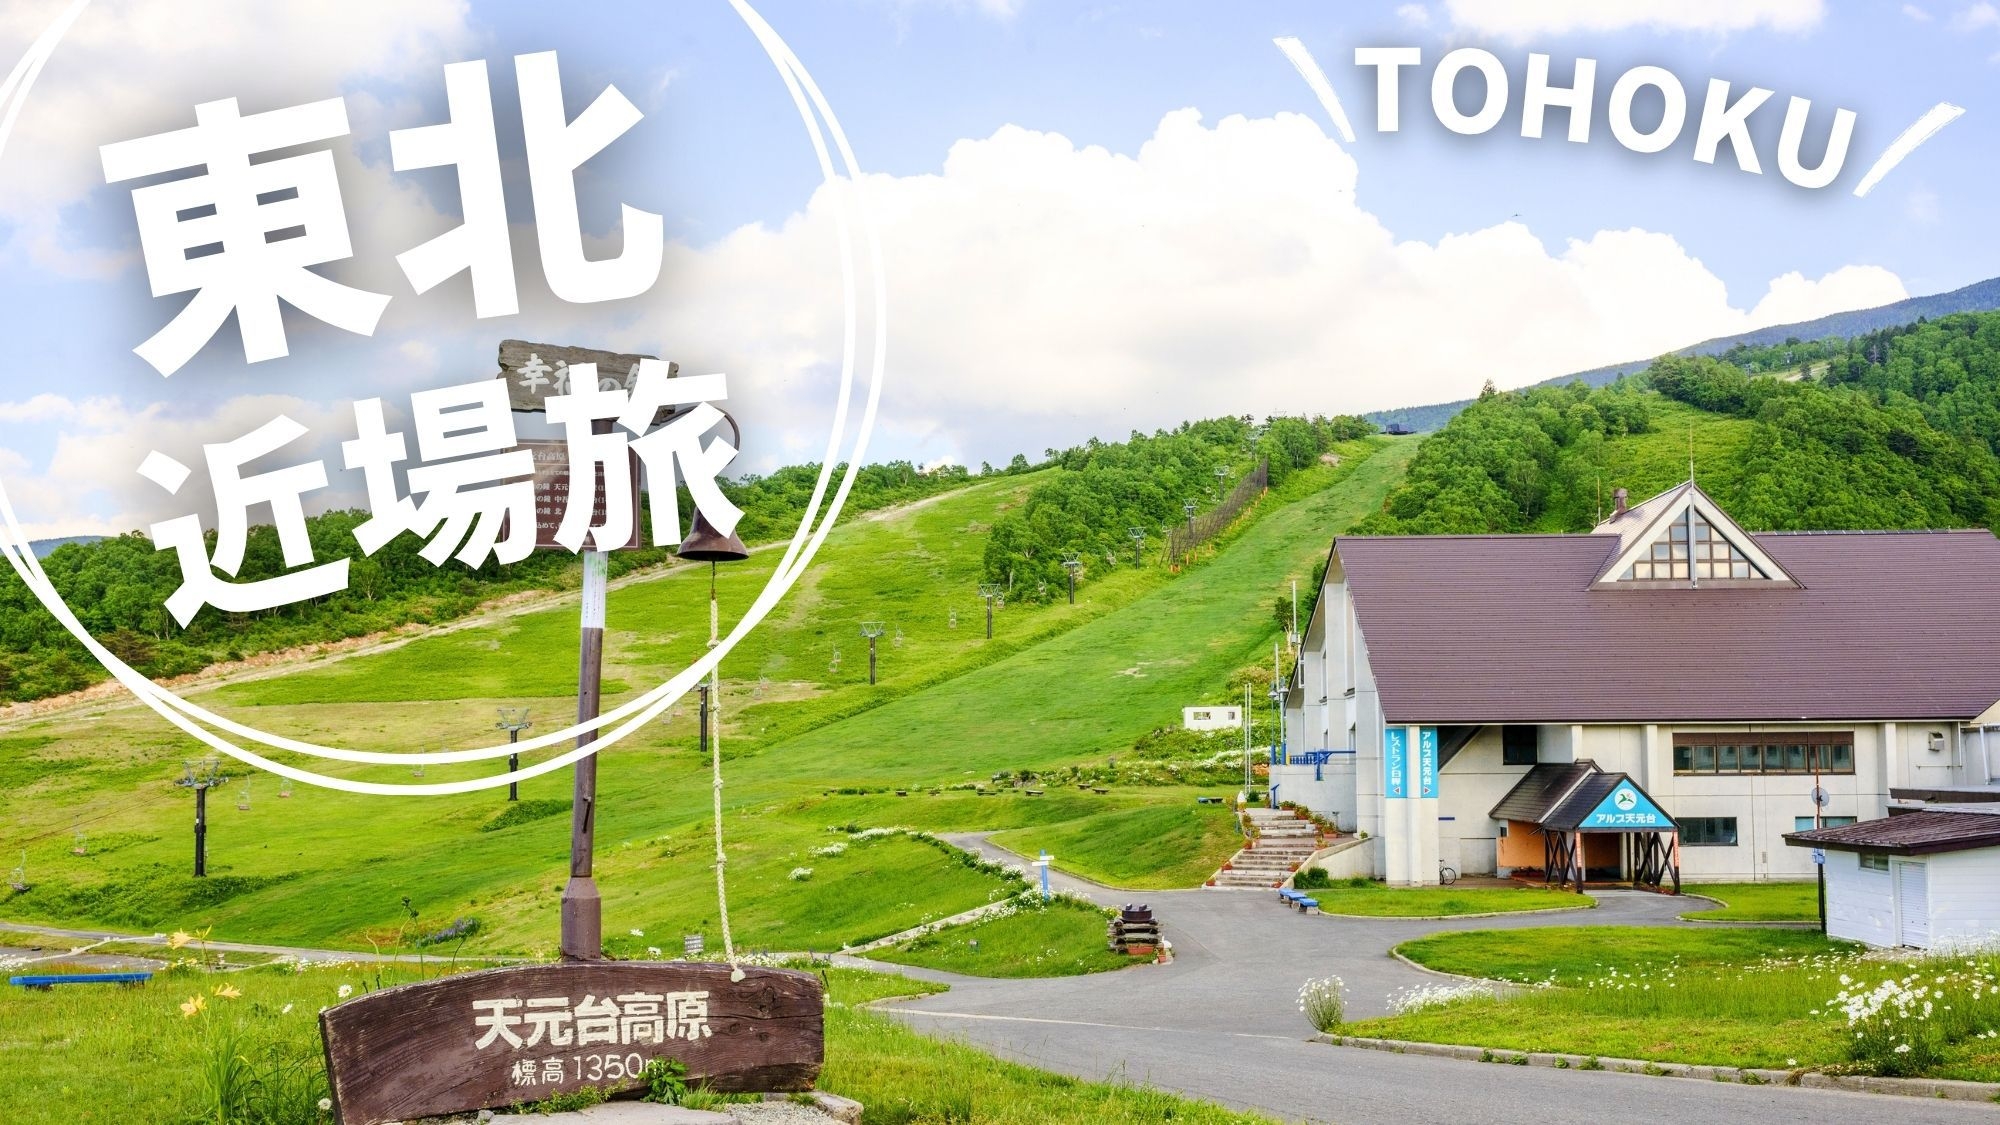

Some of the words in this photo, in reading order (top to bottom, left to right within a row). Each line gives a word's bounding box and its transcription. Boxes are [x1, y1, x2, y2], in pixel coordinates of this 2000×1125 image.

[472, 990, 712, 1050] 天元台高原
[511, 1058, 564, 1086] 標高
